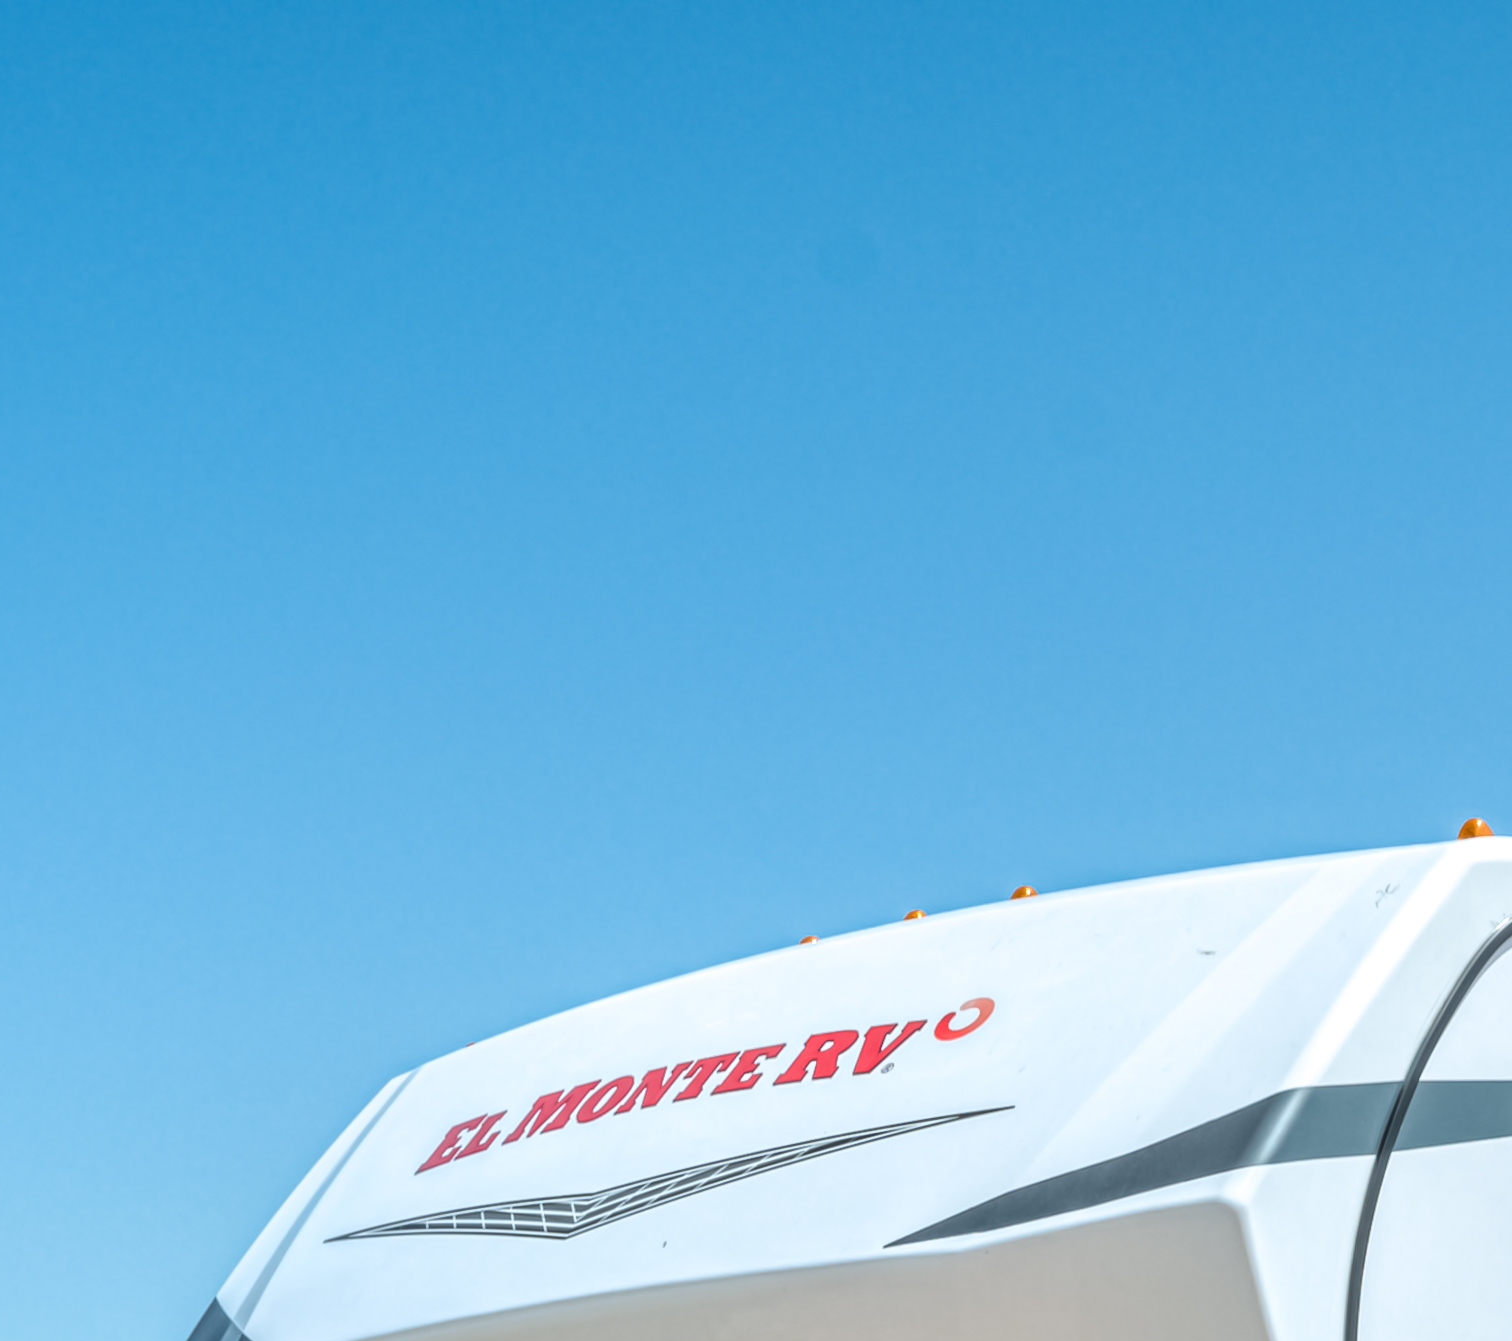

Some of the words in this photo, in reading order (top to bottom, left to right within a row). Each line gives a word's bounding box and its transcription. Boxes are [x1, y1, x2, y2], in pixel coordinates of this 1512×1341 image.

[414, 1110, 508, 1176] EL
[501, 1042, 787, 1146] MONTE
[772, 1018, 928, 1086] RV
